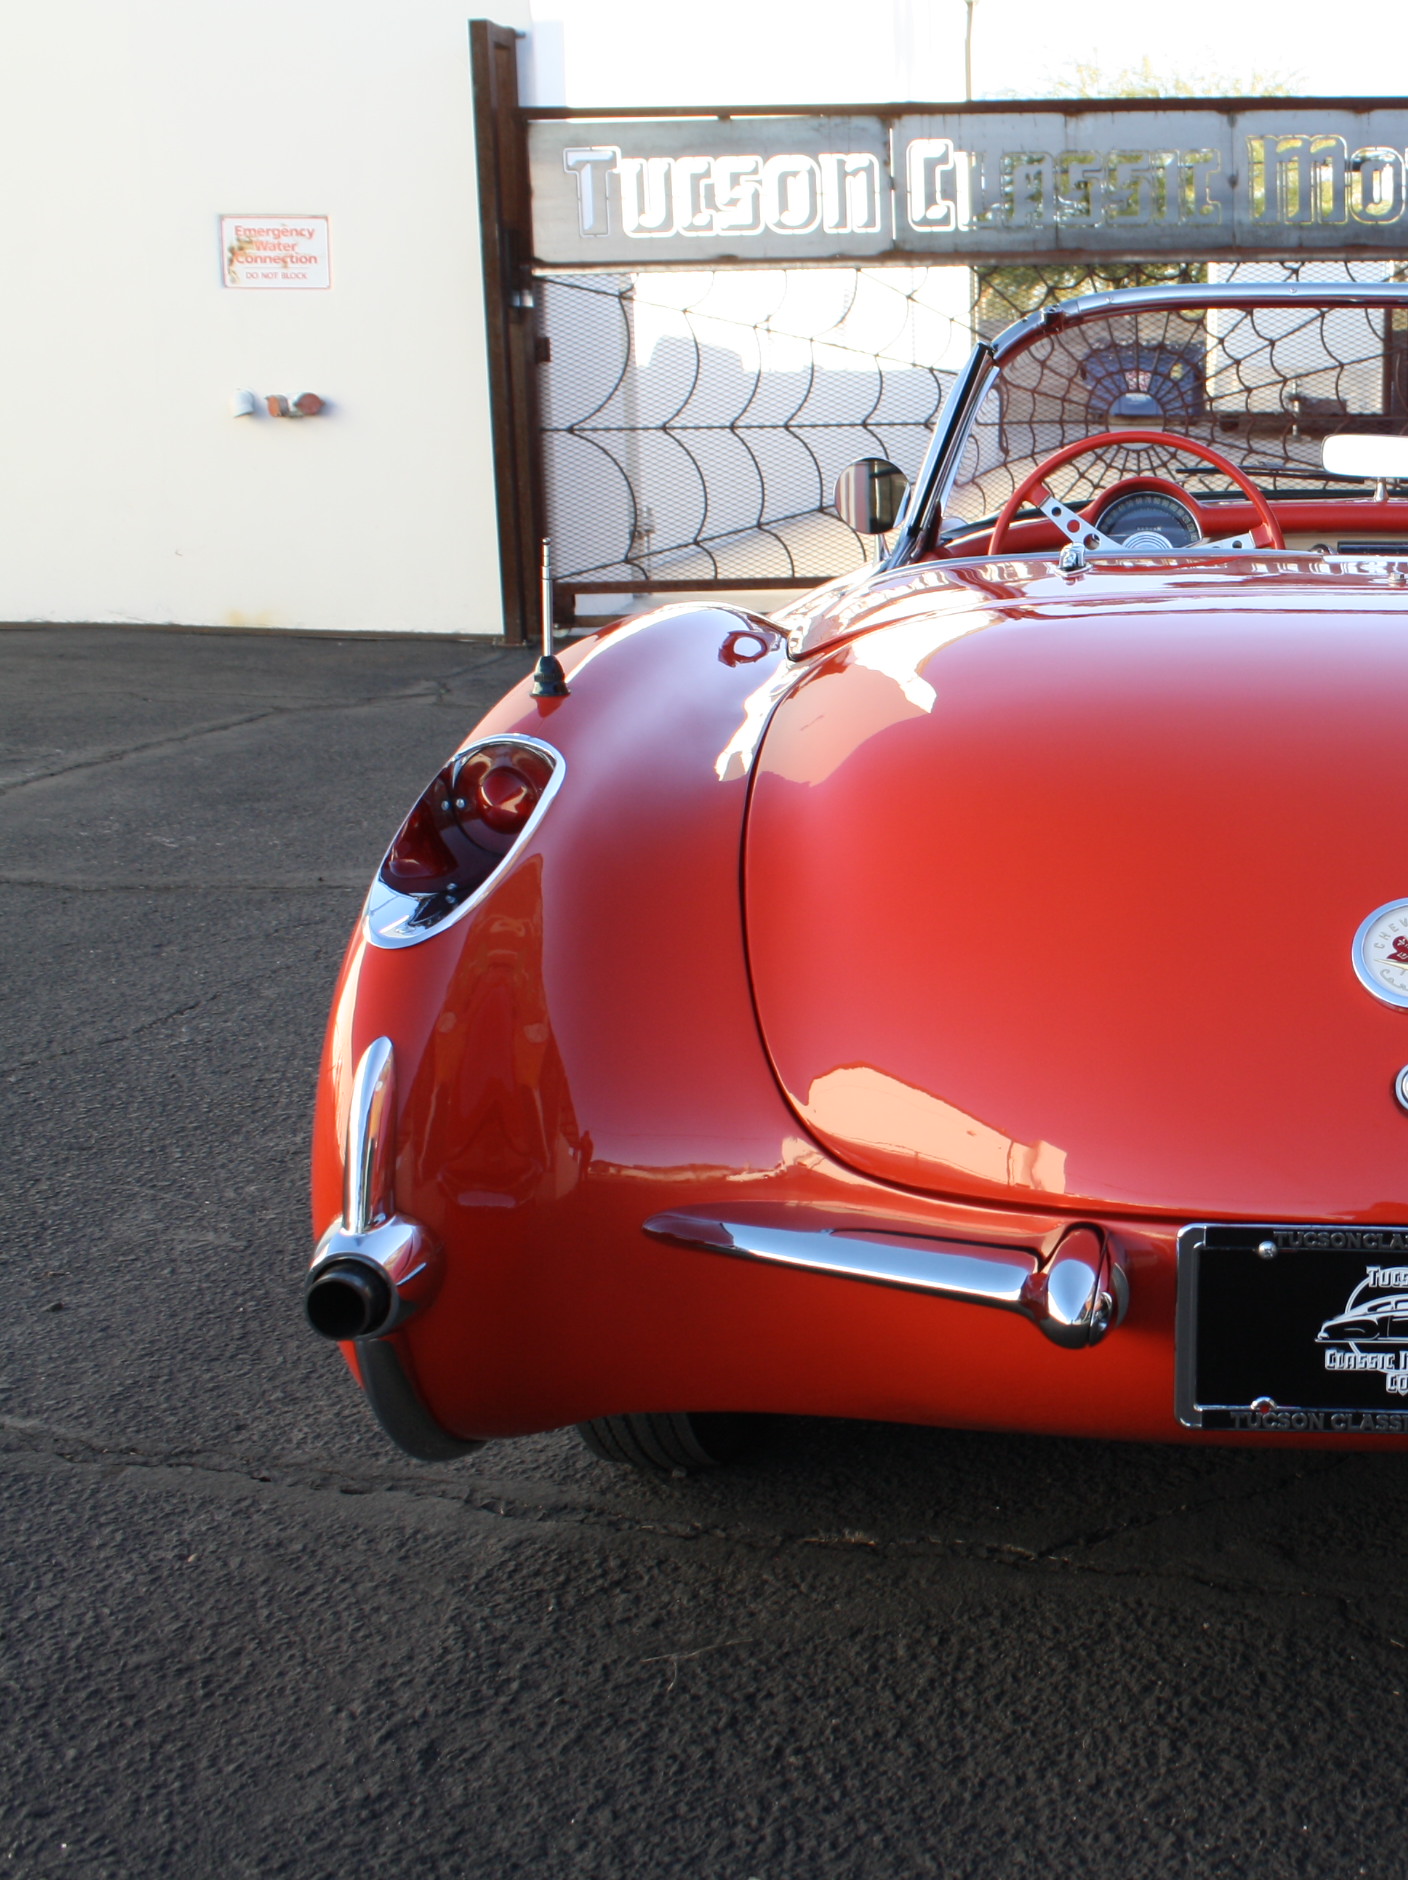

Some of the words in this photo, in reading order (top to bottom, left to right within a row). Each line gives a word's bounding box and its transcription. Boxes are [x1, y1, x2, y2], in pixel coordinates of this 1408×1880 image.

[234, 225, 315, 239] Emergency
[255, 240, 298, 252] Water
[236, 254, 318, 265] Connection
[245, 271, 259, 280] DO
[261, 271, 279, 280] NOT
[281, 271, 308, 280] BLOCK
[1230, 1411, 1324, 1430] TUCSON
